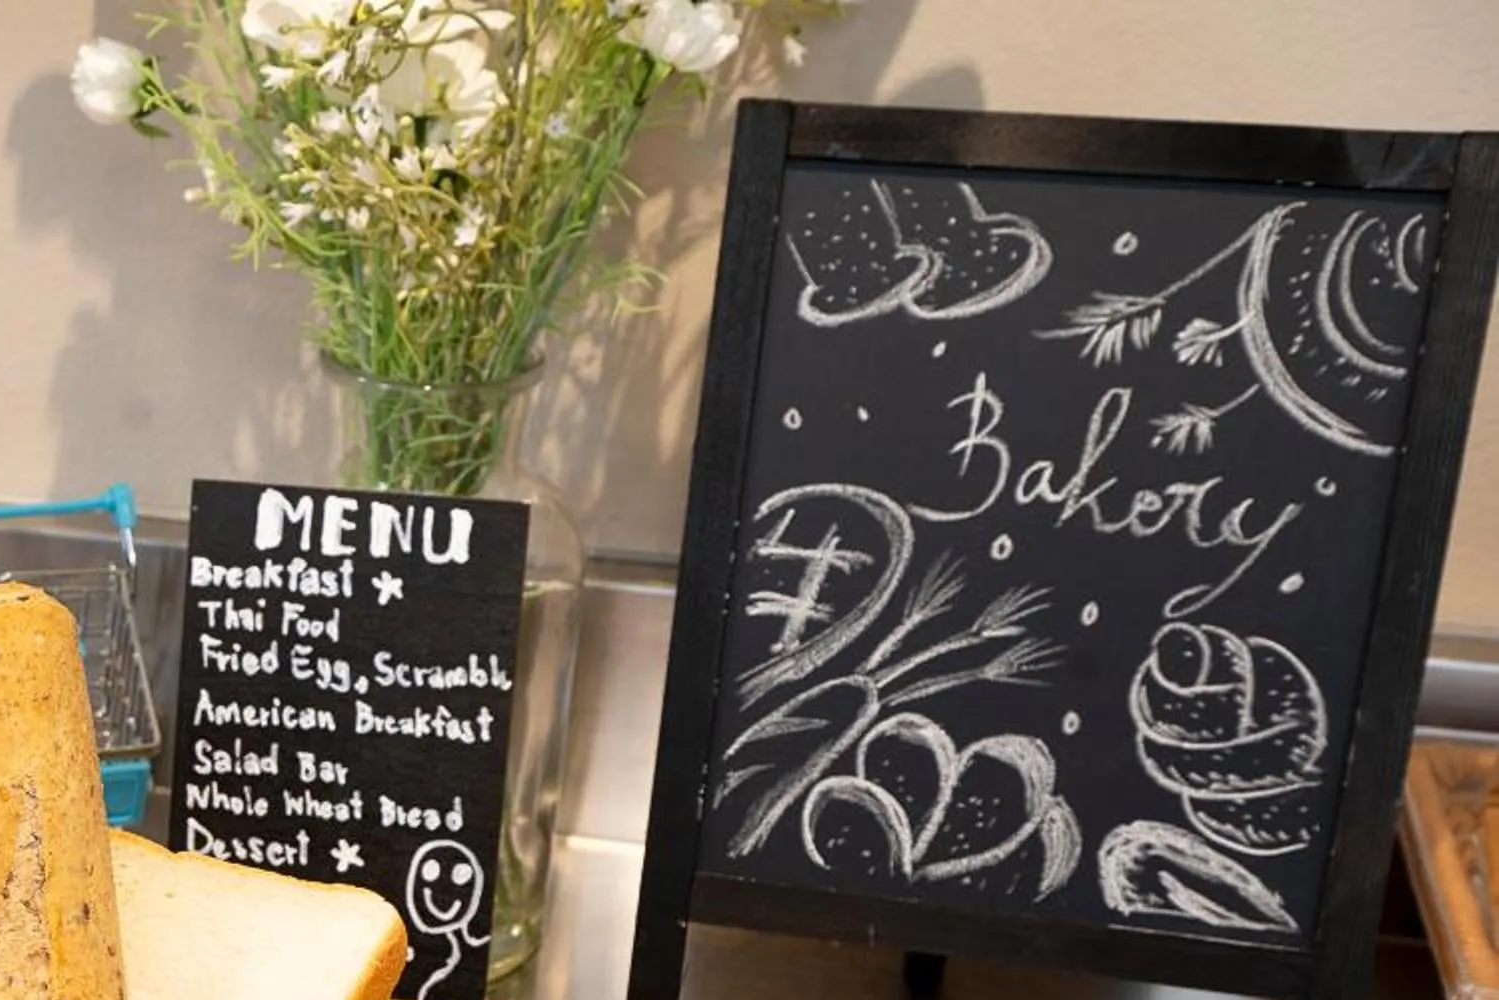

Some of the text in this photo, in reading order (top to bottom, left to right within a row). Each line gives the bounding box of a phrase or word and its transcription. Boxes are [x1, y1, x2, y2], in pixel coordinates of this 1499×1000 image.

[903, 372, 1303, 617] Bakery
[255, 488, 474, 564] MENU
[190, 556, 354, 598] Breakfast
[197, 598, 340, 643] Thai Food
[200, 633, 279, 676] Fried
[193, 688, 494, 744] American Breakfast
[193, 738, 349, 785] Salad Bar
[283, 789, 363, 822] Wheat
[379, 795, 464, 832] Bread
[187, 817, 310, 866] Dessert
